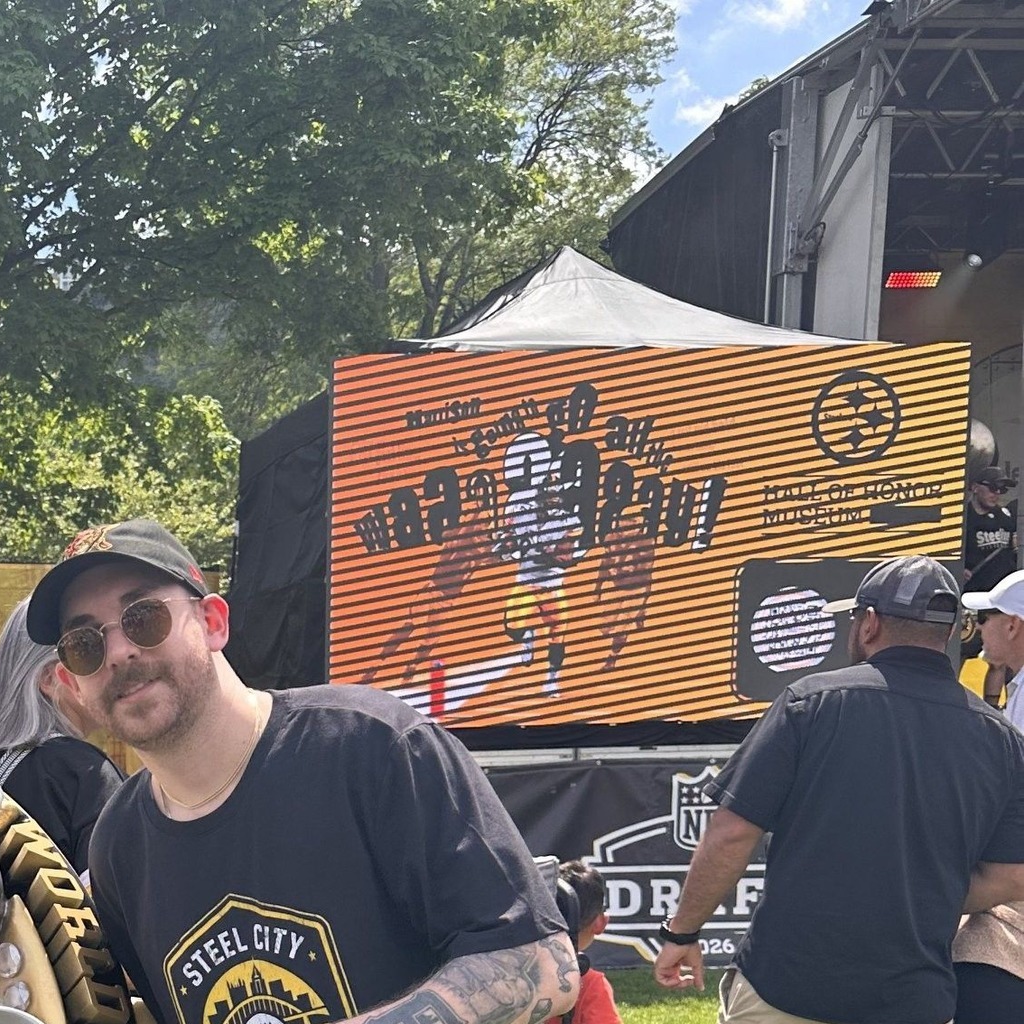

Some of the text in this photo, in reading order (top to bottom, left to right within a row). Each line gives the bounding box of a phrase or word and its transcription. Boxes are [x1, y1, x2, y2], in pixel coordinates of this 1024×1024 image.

[763, 482, 943, 501] HALL OF HONOR
[762, 508, 863, 525] MUSEUM
[182, 923, 305, 988] STEEL CITY
